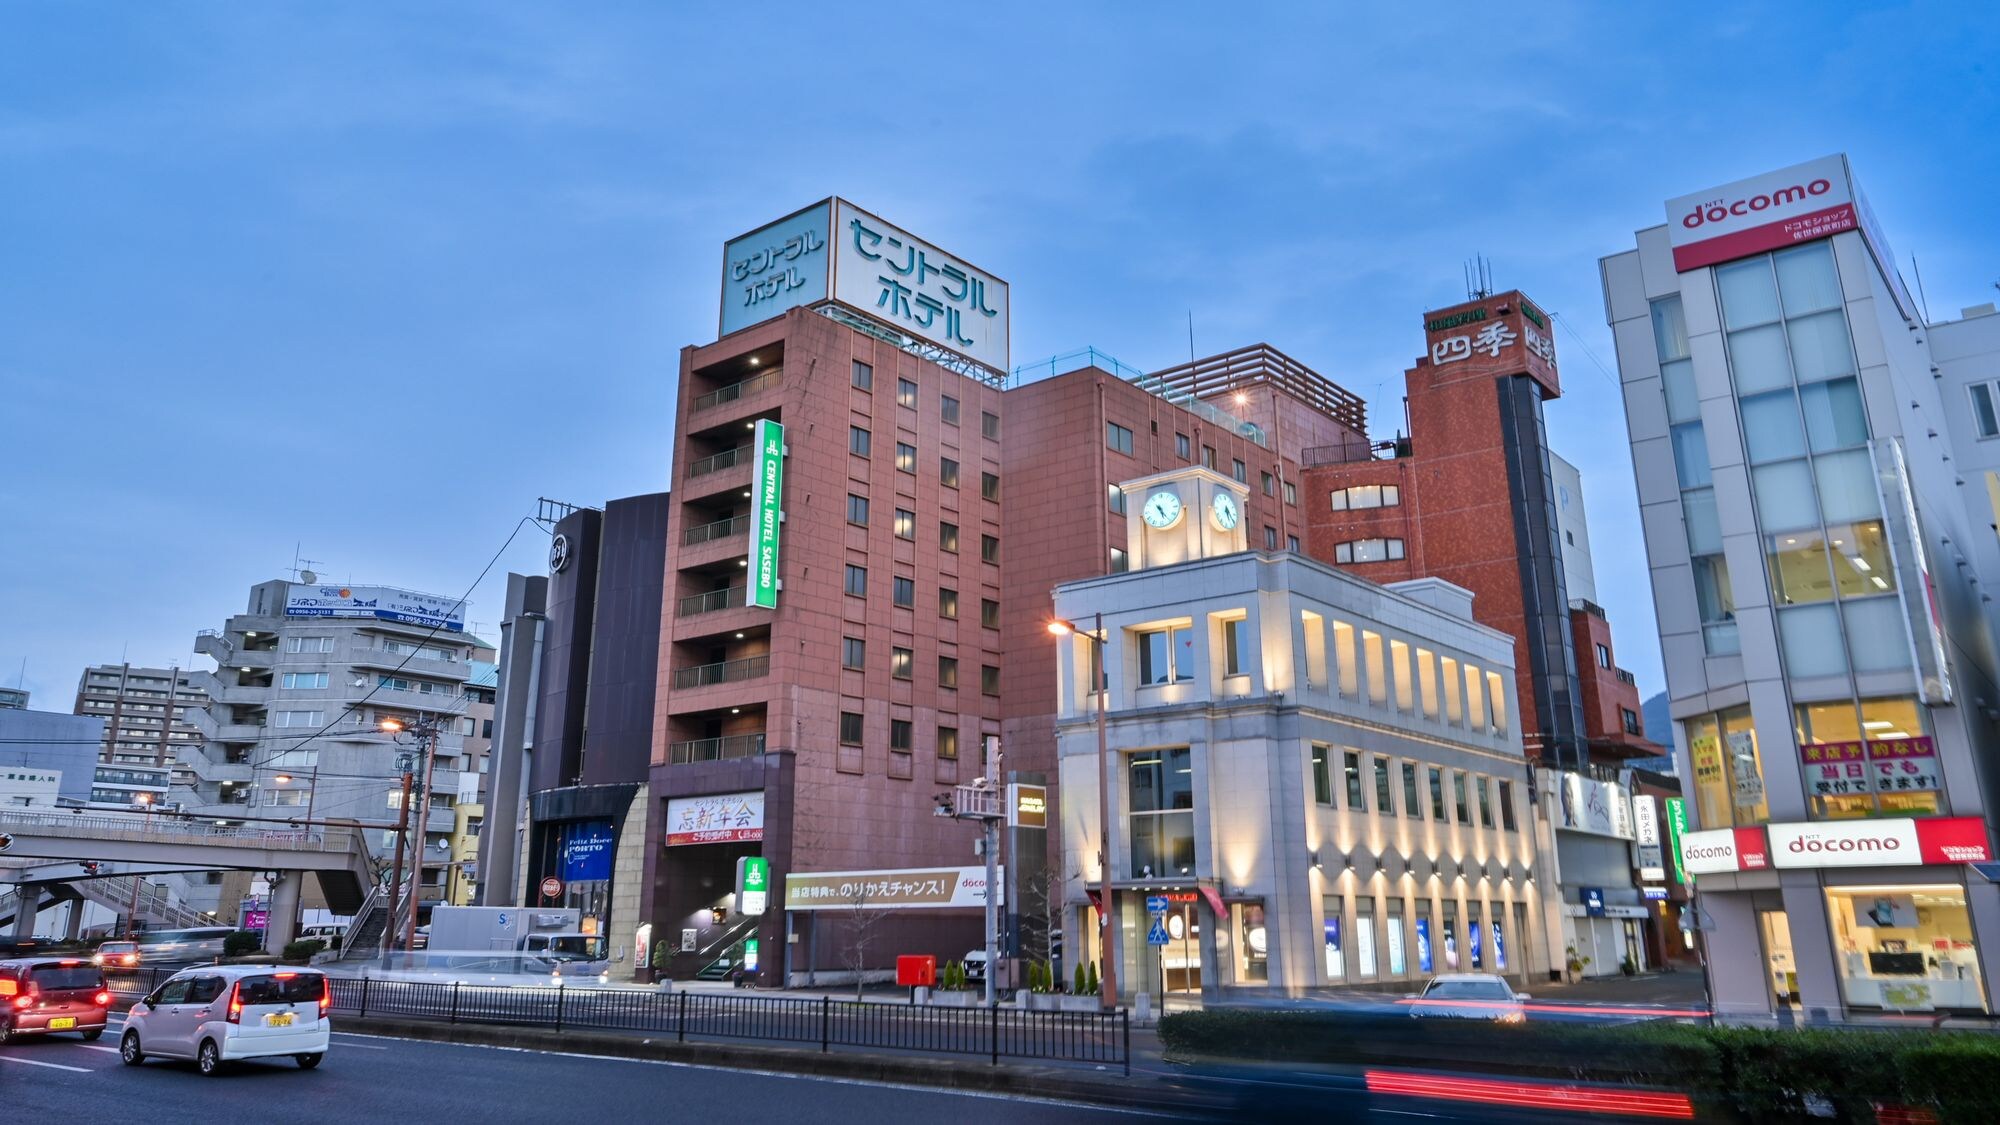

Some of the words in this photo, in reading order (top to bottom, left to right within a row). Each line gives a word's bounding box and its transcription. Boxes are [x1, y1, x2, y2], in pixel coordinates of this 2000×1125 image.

[1682, 178, 1831, 229] docomo
[1704, 198, 1724, 209] NTT
[1784, 209, 1849, 233] ドコモショップ
[731, 229, 824, 282] セントラル
[849, 218, 998, 318] セントラル
[744, 267, 806, 307] ホテル
[877, 274, 974, 346] ホテル
[1432, 321, 1517, 366] 四季
[1525, 325, 1557, 370] 四季
[765, 460, 777, 506] CENTRAL
[763, 508, 774, 543] HOTEL
[761, 546, 772, 588] SASEBO
[1806, 741, 1928, 760] 来店予約なし
[1816, 775, 1937, 794] 受付できます!
[1821, 760, 1919, 779] 当日でも
[678, 802, 756, 831] 忘新年会
[1640, 805, 1652, 844] 永田メガネ
[569, 844, 603, 853] PORTO
[1685, 843, 1732, 861] docomo
[1788, 835, 1901, 853] docomo
